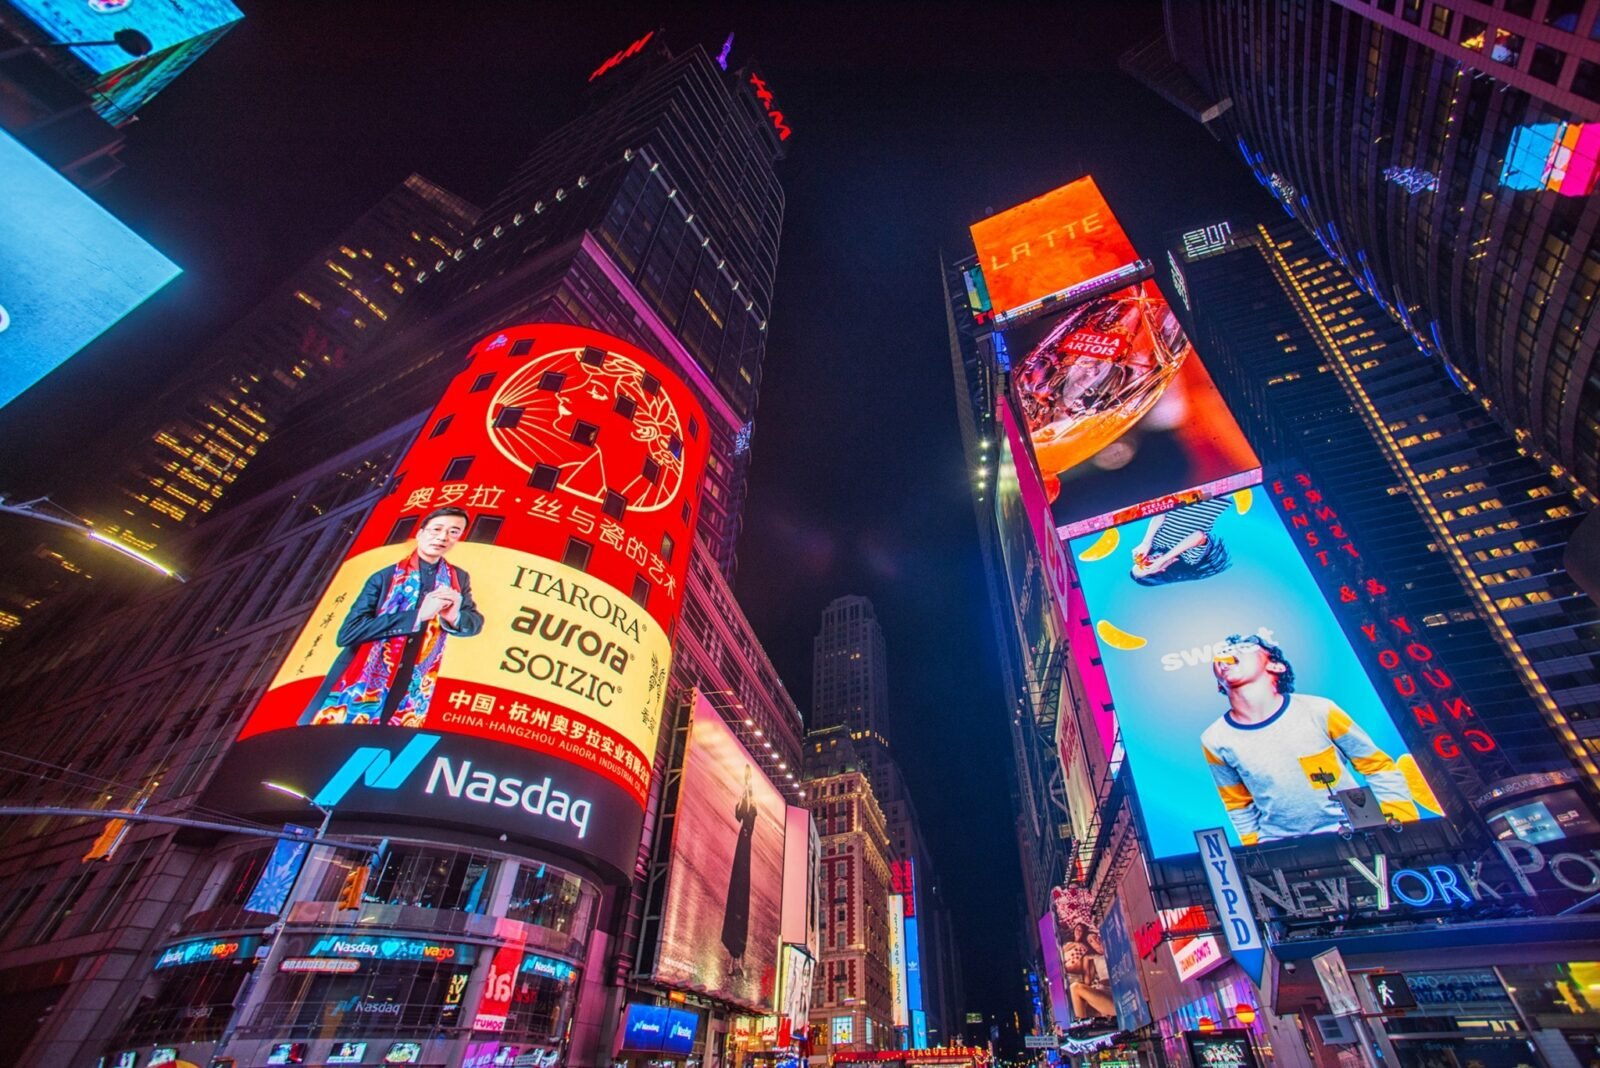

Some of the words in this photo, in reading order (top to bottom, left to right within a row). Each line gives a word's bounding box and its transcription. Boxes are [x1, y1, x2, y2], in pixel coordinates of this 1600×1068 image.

[1064, 341, 1117, 357] ARTOIS
[1072, 332, 1120, 348] STELLA
[1141, 498, 1175, 512] STELLA
[510, 565, 641, 644] ITARORA
[1272, 480, 1330, 567] ERNST
[1339, 585, 1358, 603] &
[1361, 623, 1461, 759] YOUNG
[511, 605, 629, 675] aurora
[500, 646, 616, 707] SOIZIC
[559, 739, 596, 762] AURORA
[599, 757, 634, 786] INDUSTRIAL
[424, 756, 592, 839] Nasdaq
[1204, 833, 1251, 946] NYPD
[1347, 854, 1503, 910] YORK
[1494, 840, 1600, 897] PO
[333, 941, 379, 956] Nasdaq
[408, 942, 455, 963] trivago
[354, 1001, 401, 1016] Nasdaq
[909, 1046, 970, 1059] TAQUERIA
